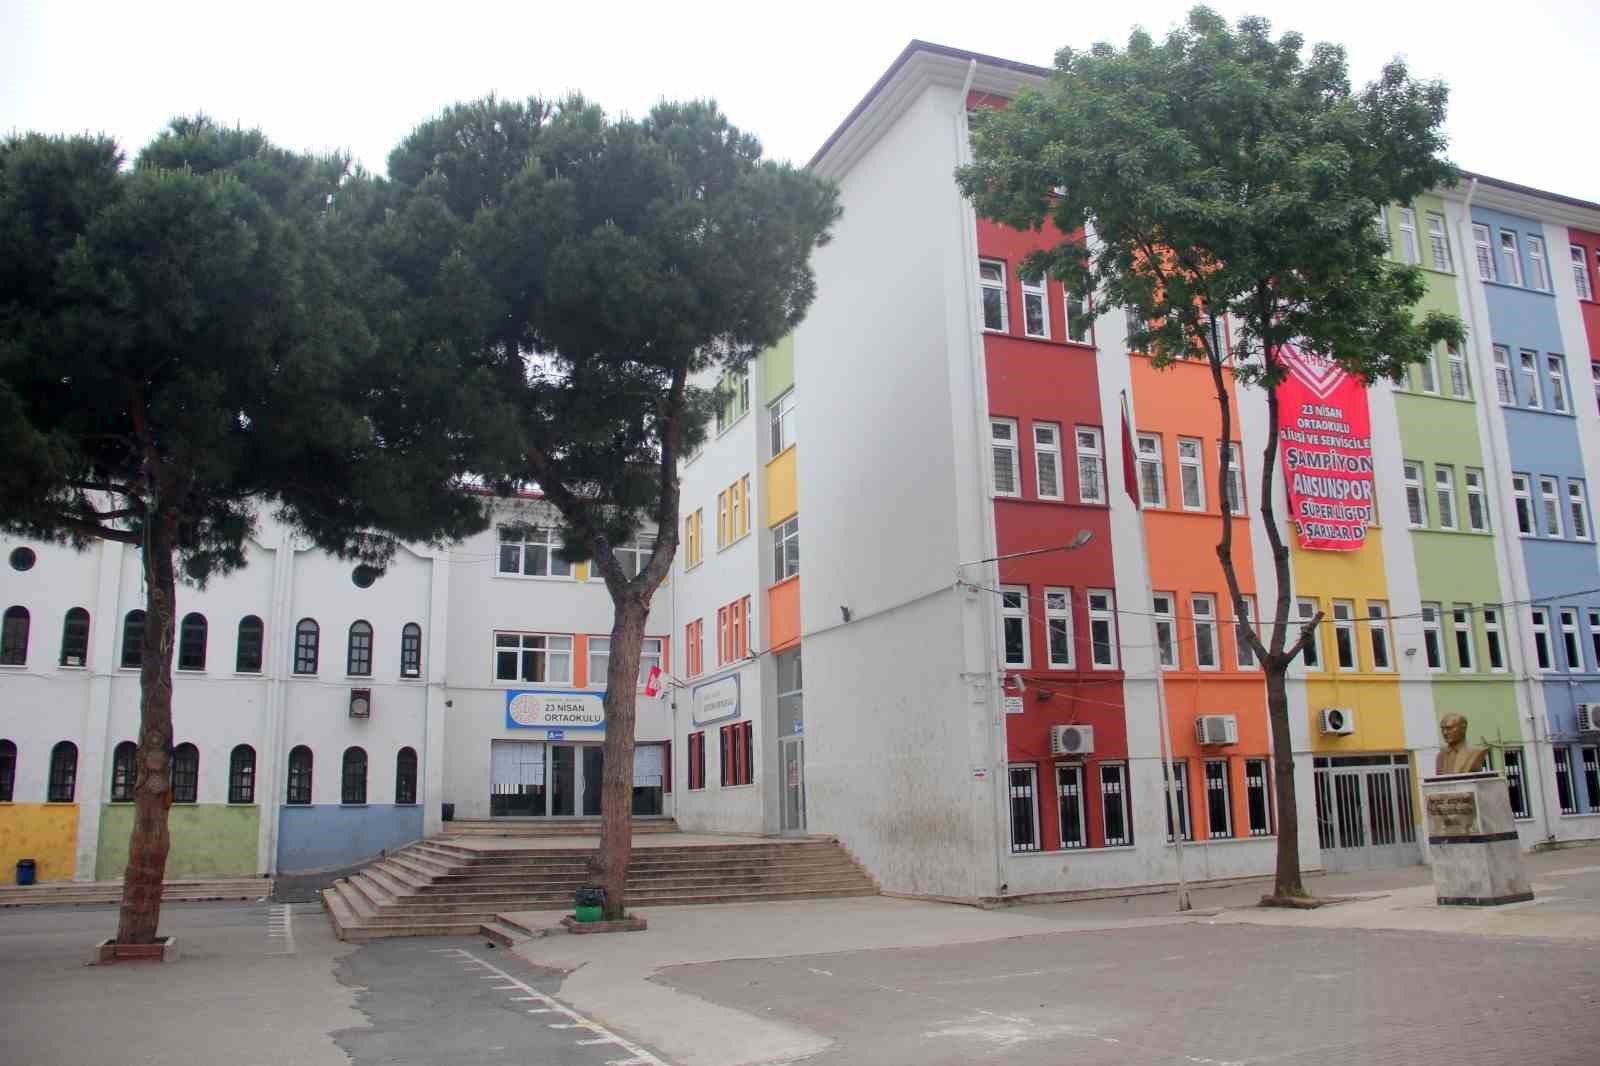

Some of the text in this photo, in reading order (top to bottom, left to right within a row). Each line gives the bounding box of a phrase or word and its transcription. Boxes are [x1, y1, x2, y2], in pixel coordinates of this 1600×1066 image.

[1302, 404, 1313, 415] 23
[1297, 418, 1350, 433] ORTAOKULU
[1288, 449, 1373, 473] ŞAMPİYON
[545, 704, 555, 712] 23
[544, 713, 601, 722] ORTAOKULU
